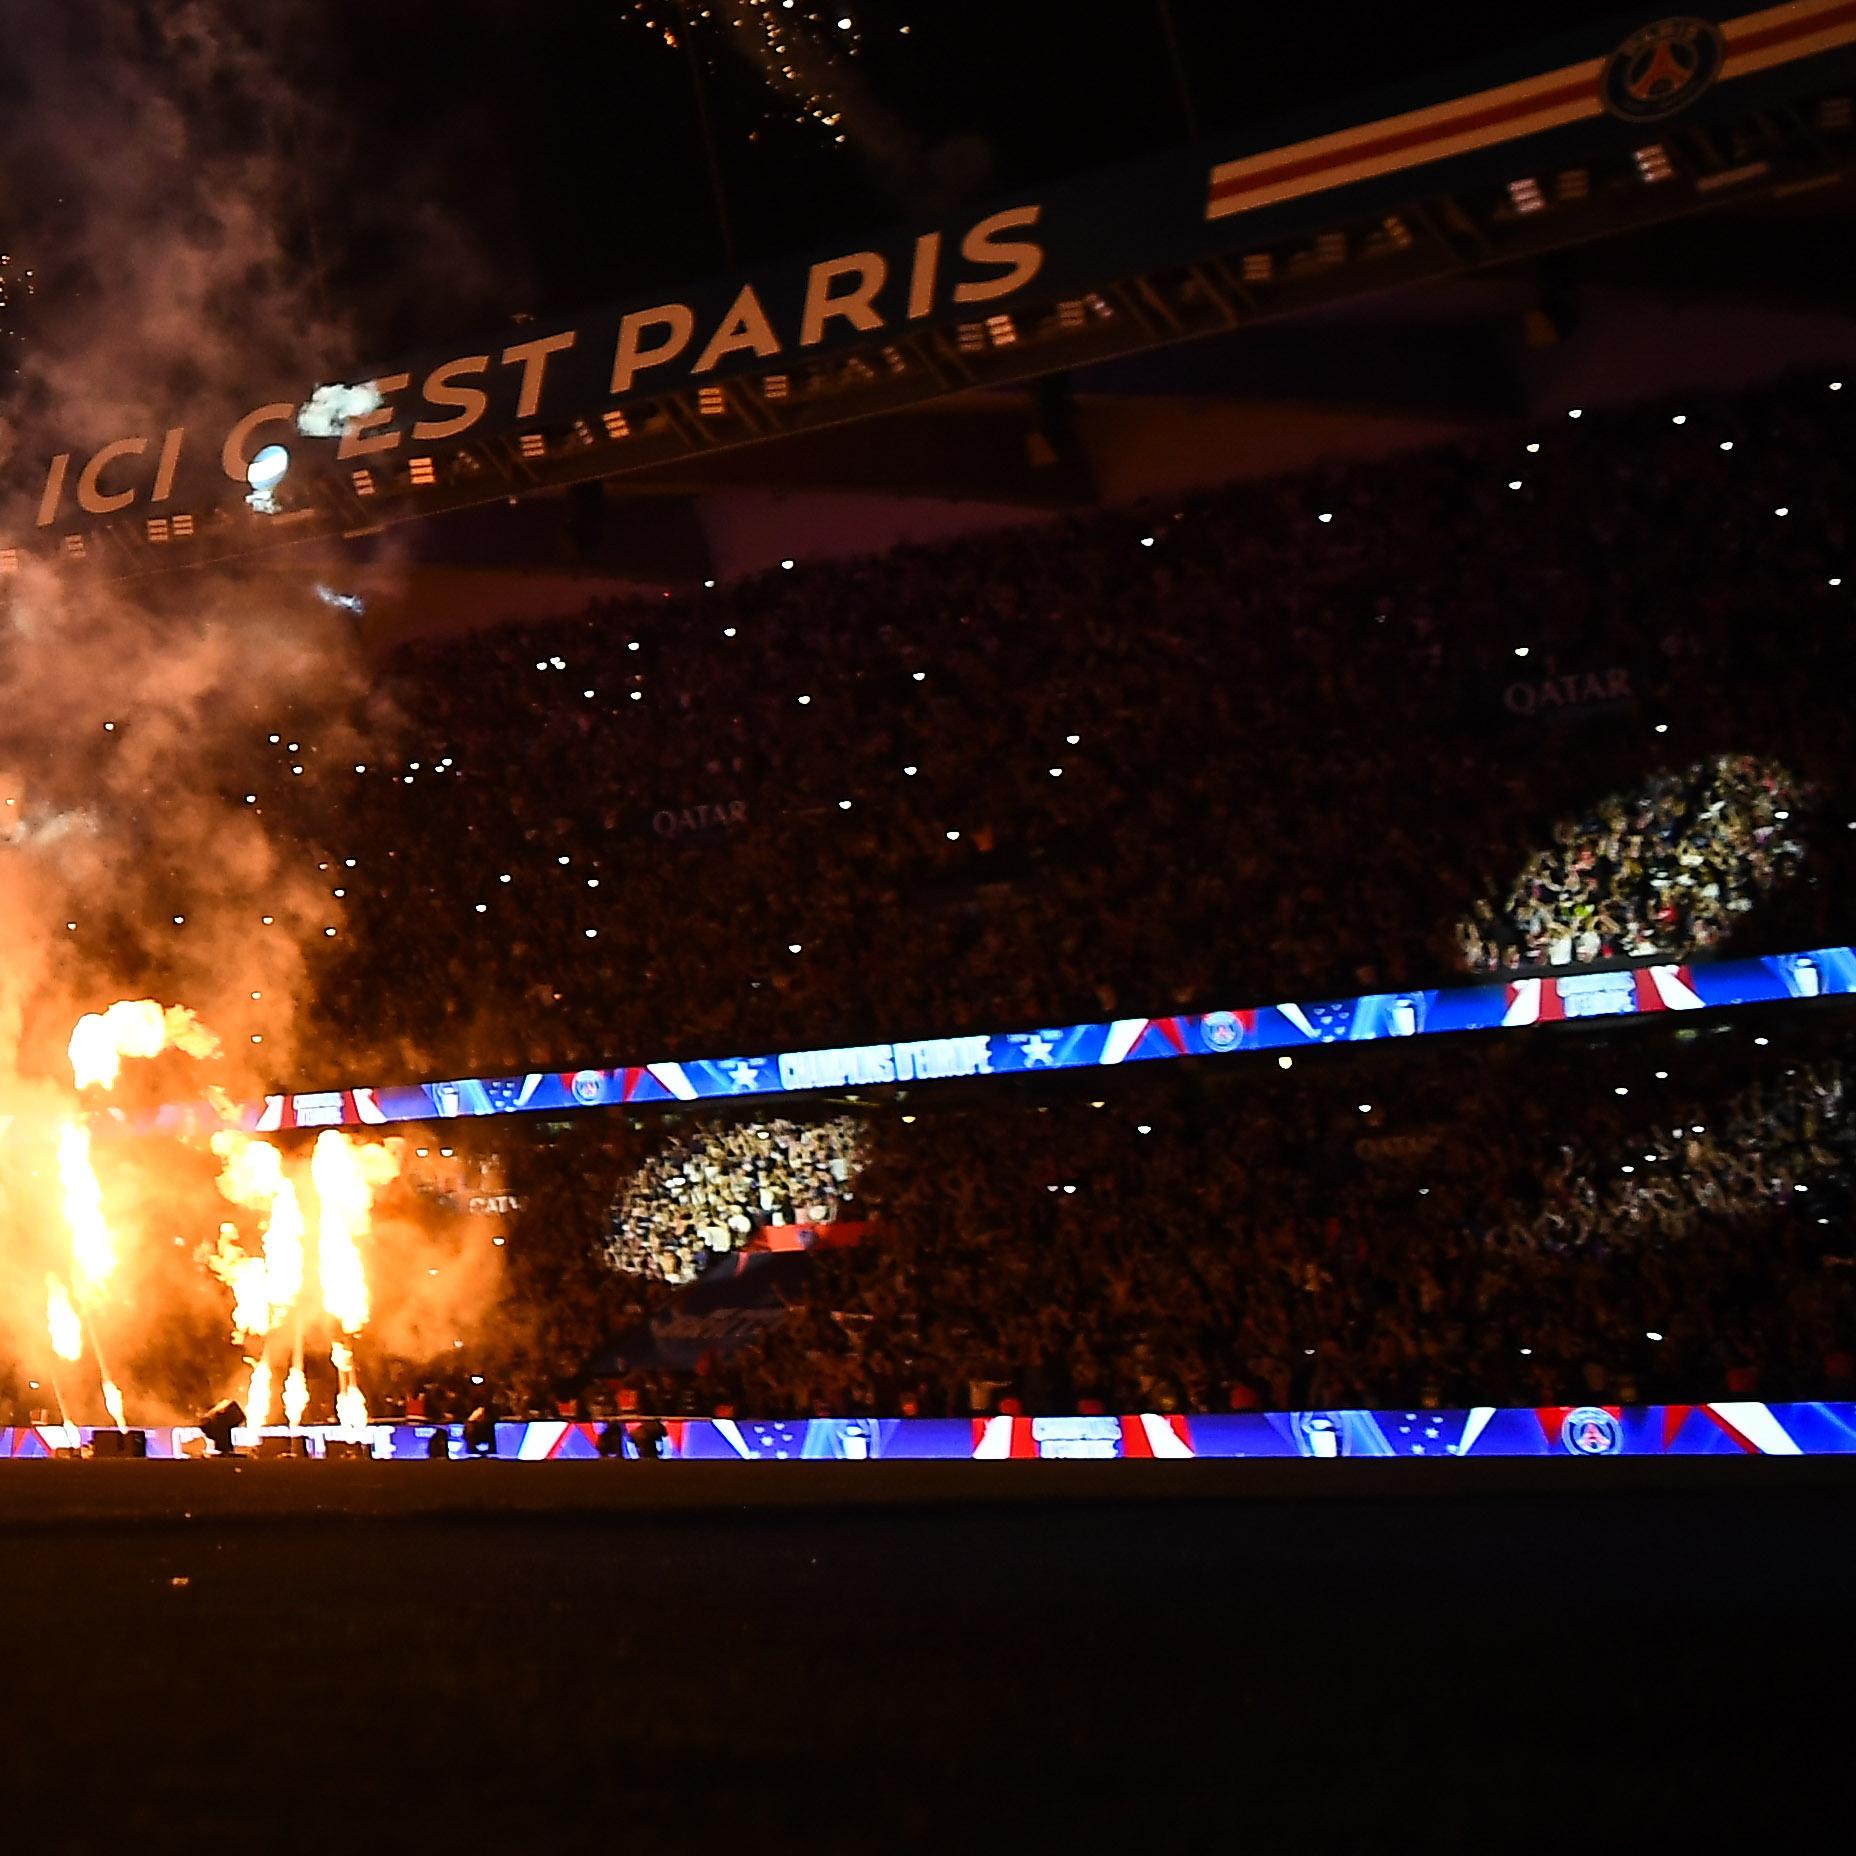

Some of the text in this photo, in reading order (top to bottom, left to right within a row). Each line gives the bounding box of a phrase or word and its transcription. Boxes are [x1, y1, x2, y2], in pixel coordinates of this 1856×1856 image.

[38, 203, 1044, 526] ICI CEST PARIS
